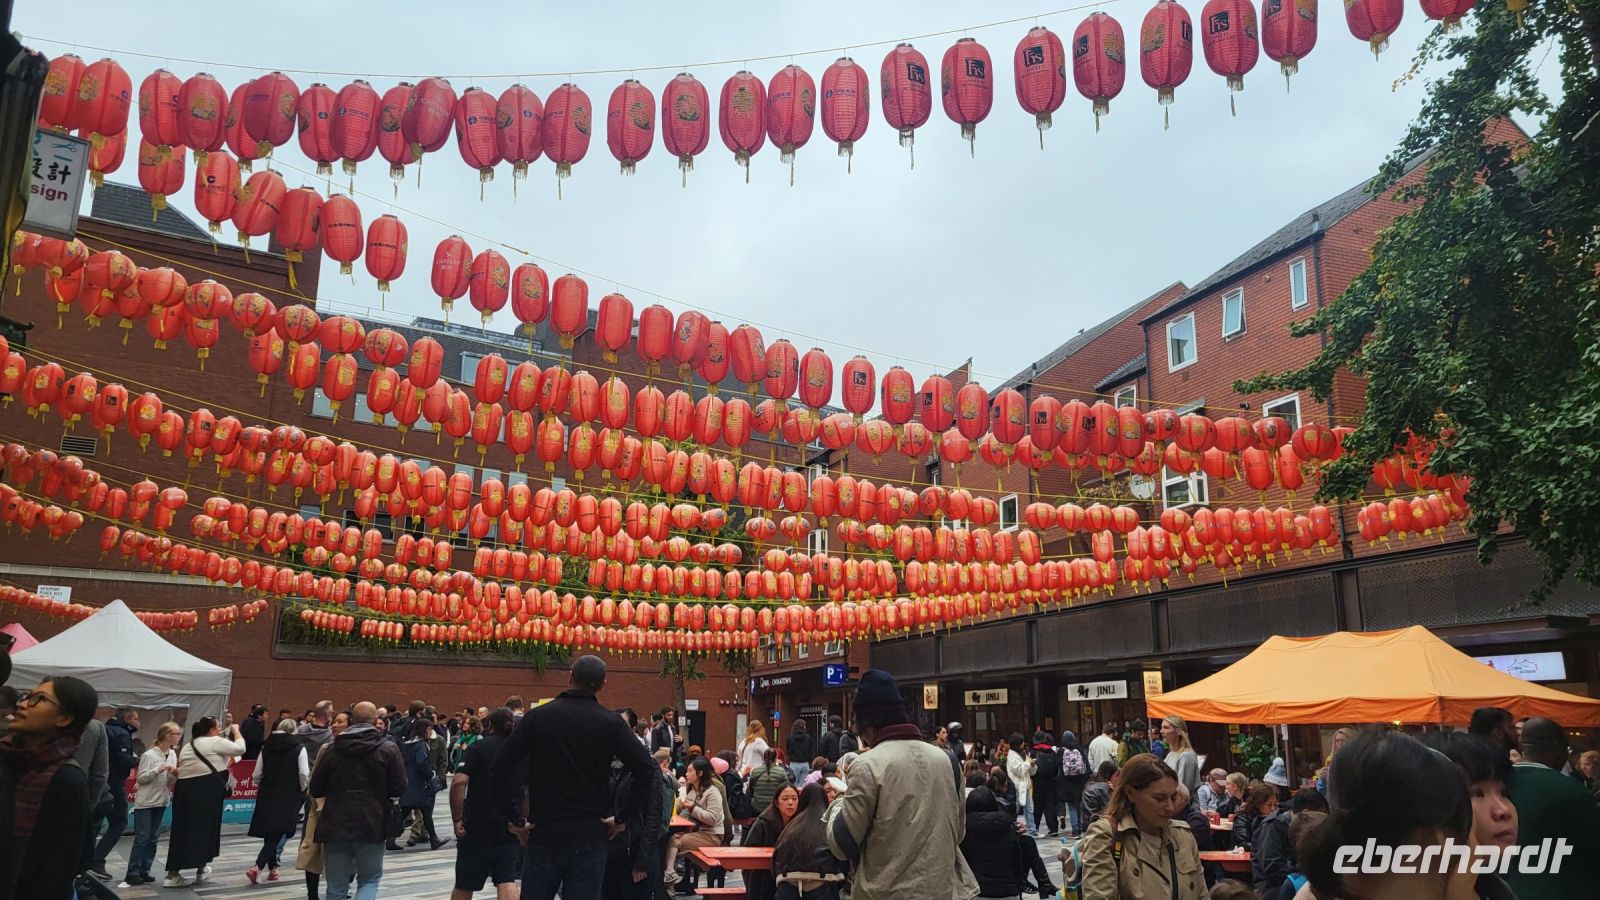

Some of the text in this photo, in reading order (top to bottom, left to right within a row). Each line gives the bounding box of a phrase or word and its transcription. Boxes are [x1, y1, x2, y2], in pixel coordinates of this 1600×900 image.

[827, 667, 835, 680] P
[985, 692, 1000, 702] JINLI
[1096, 685, 1116, 698] JINLI
